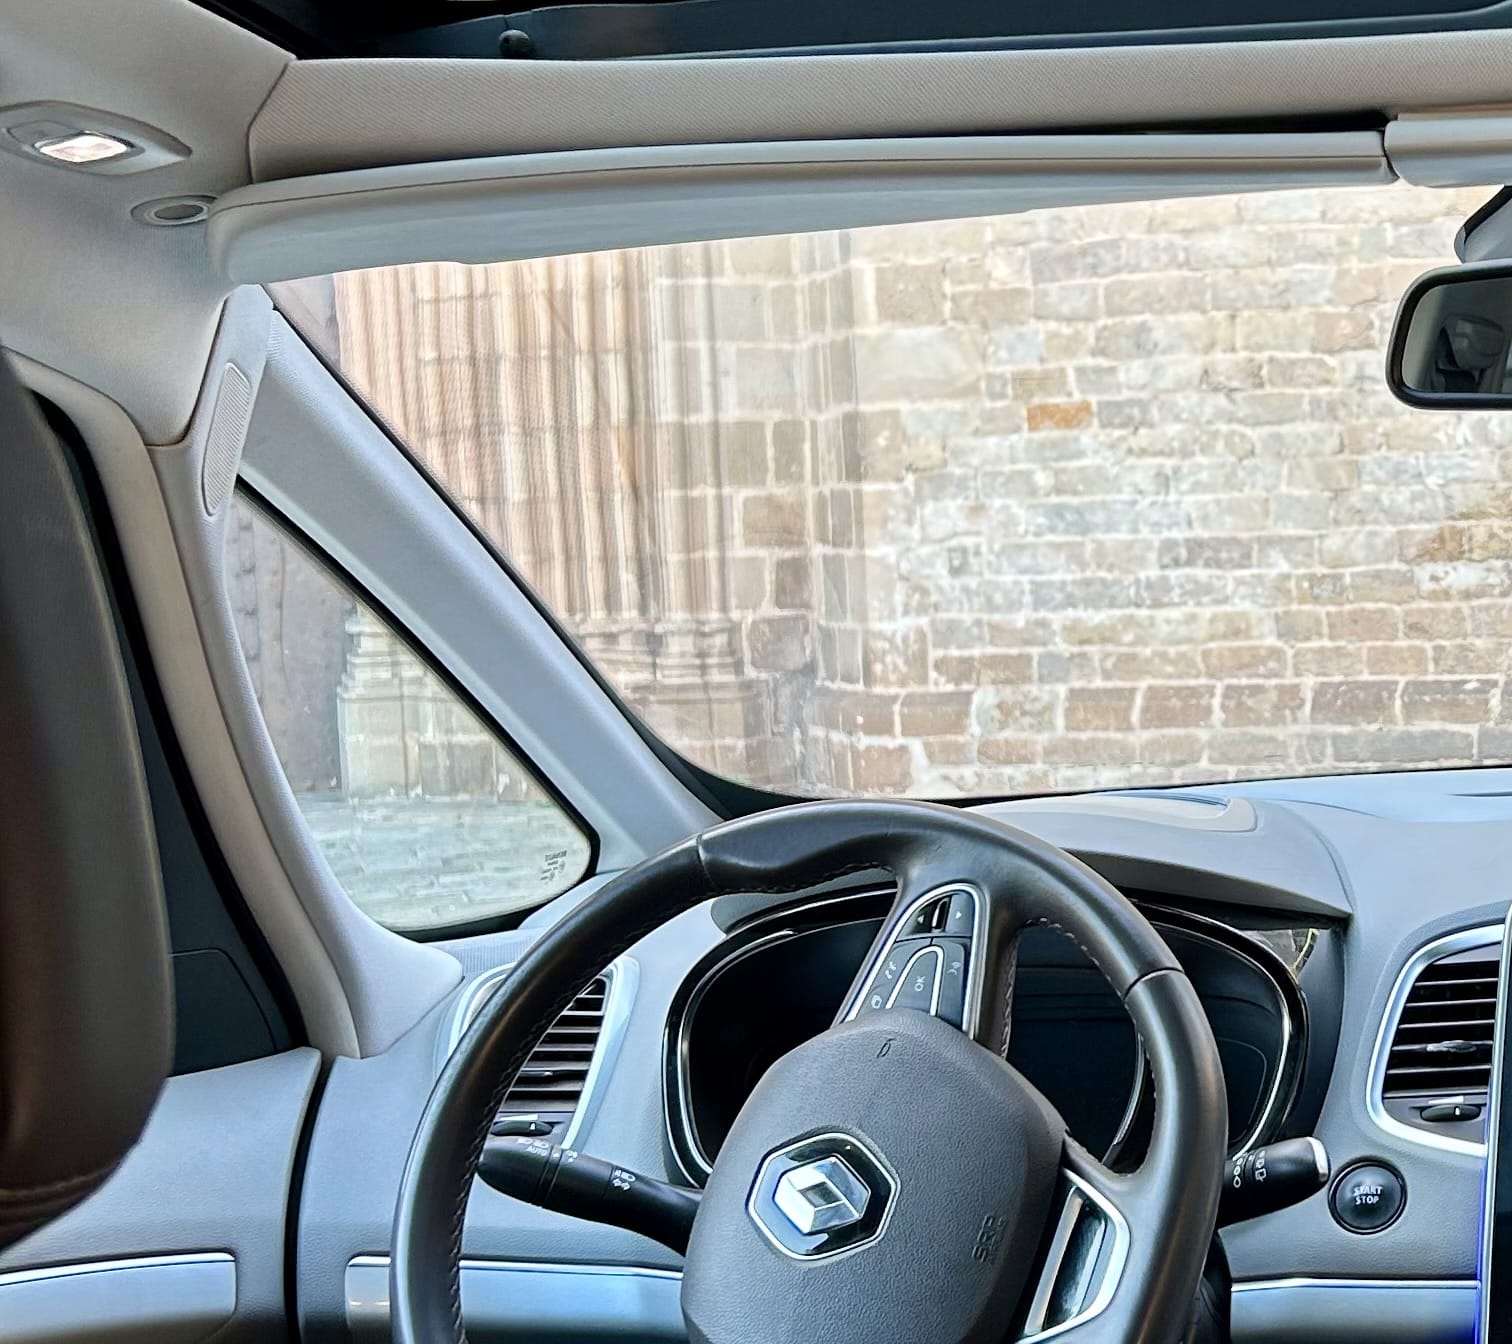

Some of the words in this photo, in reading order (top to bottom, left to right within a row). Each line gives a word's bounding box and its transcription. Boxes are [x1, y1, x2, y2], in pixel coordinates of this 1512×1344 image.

[914, 975, 926, 992] OK
[526, 1145, 549, 1157] AUTO
[1353, 1184, 1384, 1197] START
[1355, 1194, 1380, 1205] STOP
